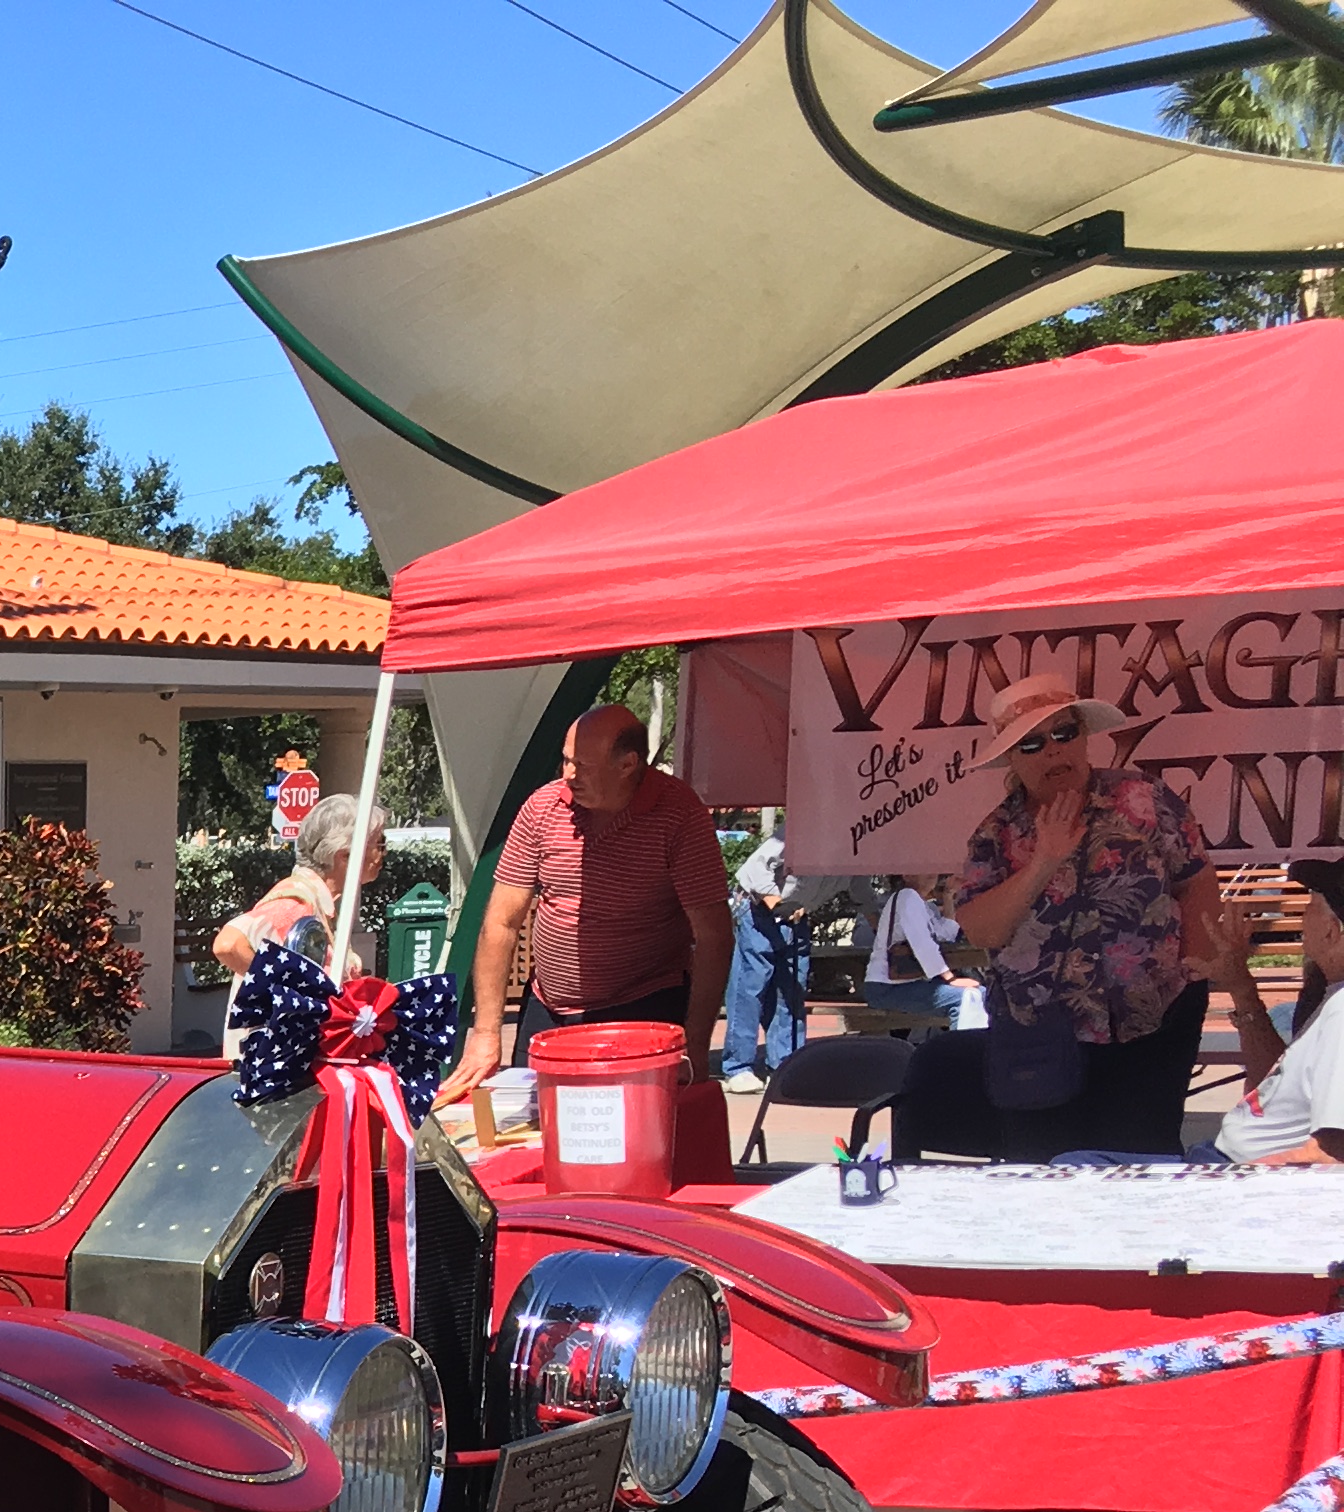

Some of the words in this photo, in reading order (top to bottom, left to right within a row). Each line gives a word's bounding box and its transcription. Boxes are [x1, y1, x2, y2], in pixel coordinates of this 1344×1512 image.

[857, 736, 924, 801] Let's
[280, 786, 320, 808] STOP
[850, 776, 940, 857] preserve
[945, 737, 979, 785] it!
[283, 828, 297, 836] ALL
[413, 929, 432, 980] CYCLE
[560, 1089, 622, 1100] DONATIONS
[566, 1105, 587, 1116] FOR
[590, 1105, 614, 1117] OLD
[570, 1121, 611, 1133] BETSY'S
[561, 1137, 623, 1149] CONTINUED
[576, 1154, 604, 1163] CARE
